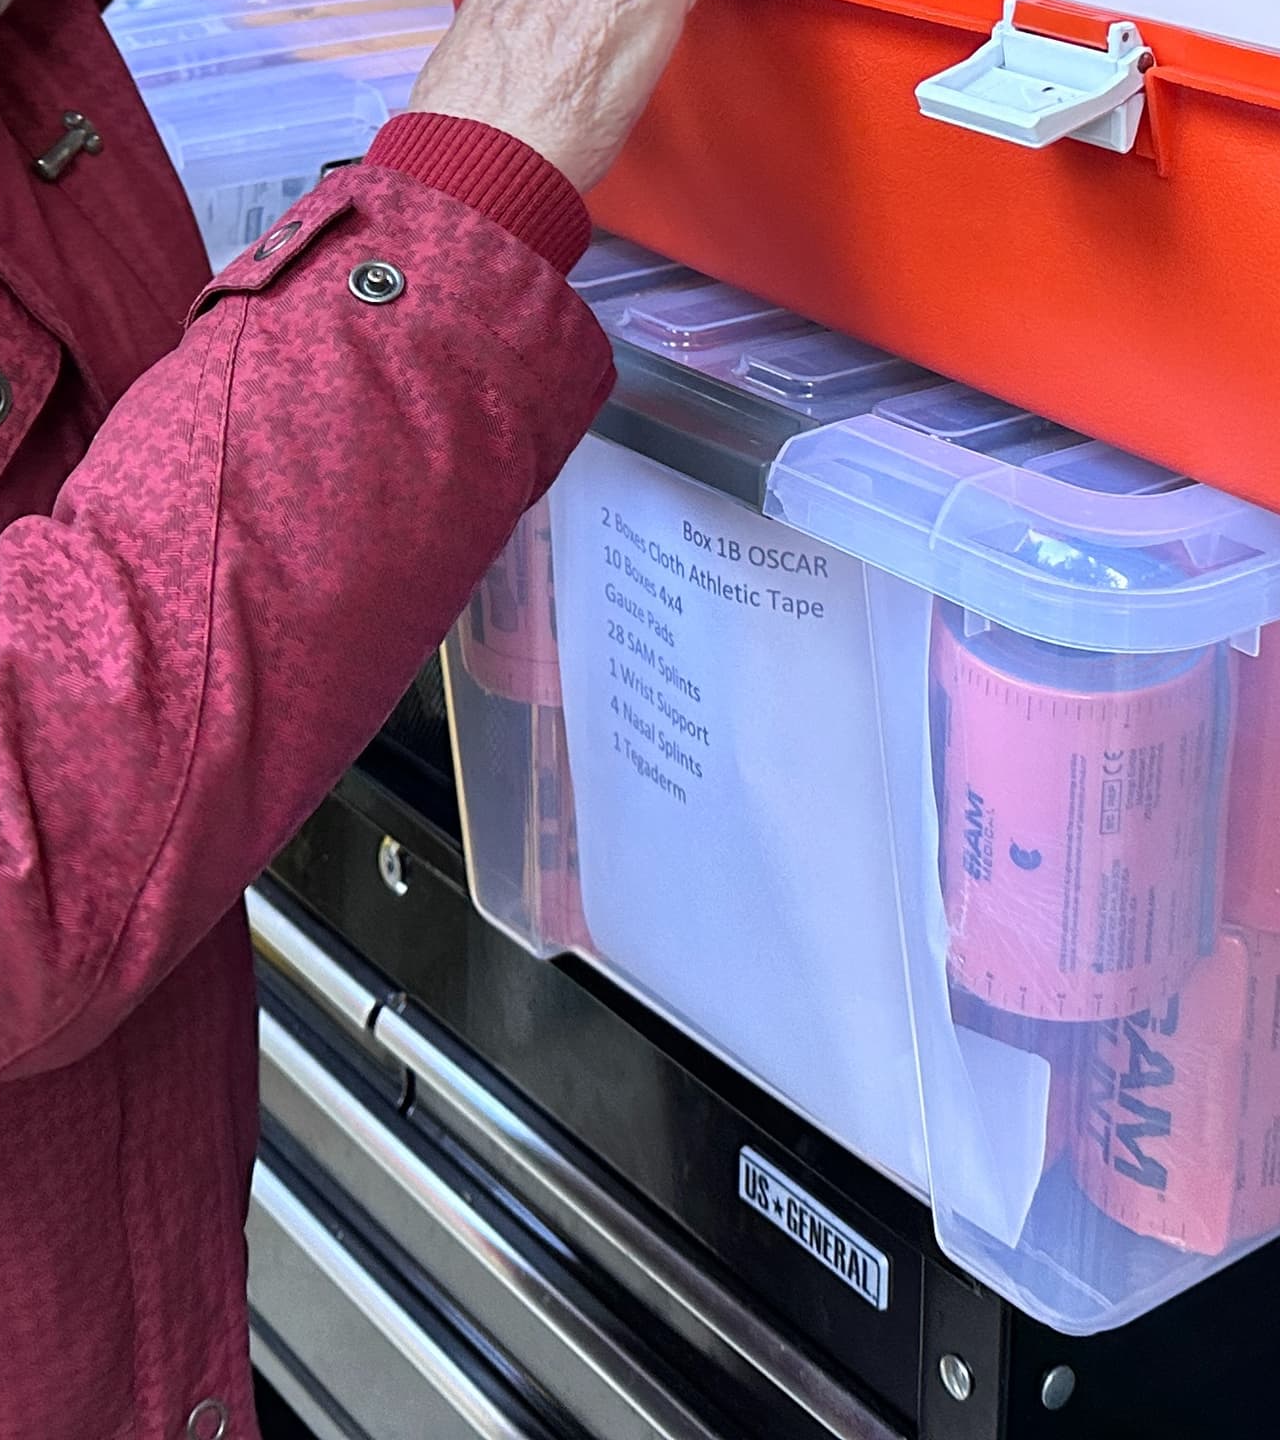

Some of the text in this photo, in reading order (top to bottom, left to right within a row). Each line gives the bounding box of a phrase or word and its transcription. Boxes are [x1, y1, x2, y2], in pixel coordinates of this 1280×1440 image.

[601, 506, 825, 620] 2 Boxes Cloth Athletic Tape
[604, 545, 683, 616] 10 Boxes 4x4
[682, 520, 829, 578] Box 1B OSCAR
[604, 582, 675, 648] Gauze Pads
[607, 619, 701, 703] 28 SAM Splints
[609, 657, 710, 747] 1 Wrist Support
[610, 695, 703, 779] 4 Nasal Splints
[613, 731, 687, 804] 1 Tegaderm
[744, 1162, 877, 1298] US GENERAL
